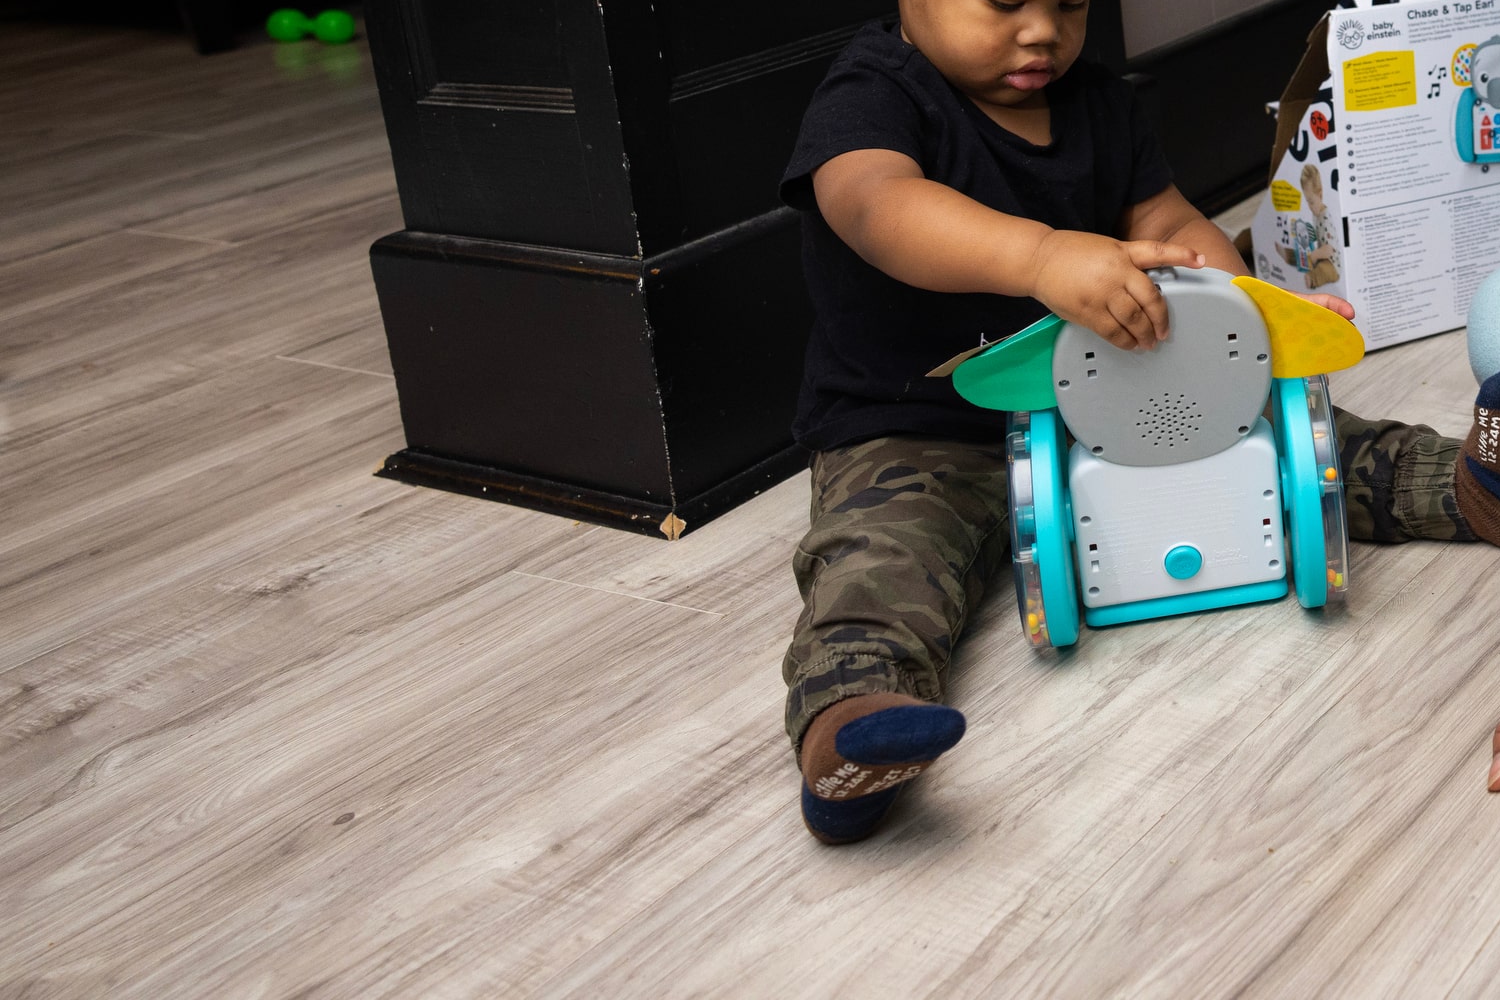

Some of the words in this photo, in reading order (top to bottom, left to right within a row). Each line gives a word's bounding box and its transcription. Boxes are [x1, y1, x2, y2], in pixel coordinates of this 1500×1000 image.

[1407, 7, 1439, 20] Chase
[1442, 5, 1450, 16] &
[1452, 1, 1472, 14] Tap
[1366, 29, 1401, 41] einstein
[1372, 21, 1394, 32] baby
[1478, 408, 1488, 427] Me
[1488, 416, 1500, 463] 12-24M
[833, 762, 860, 779] Me
